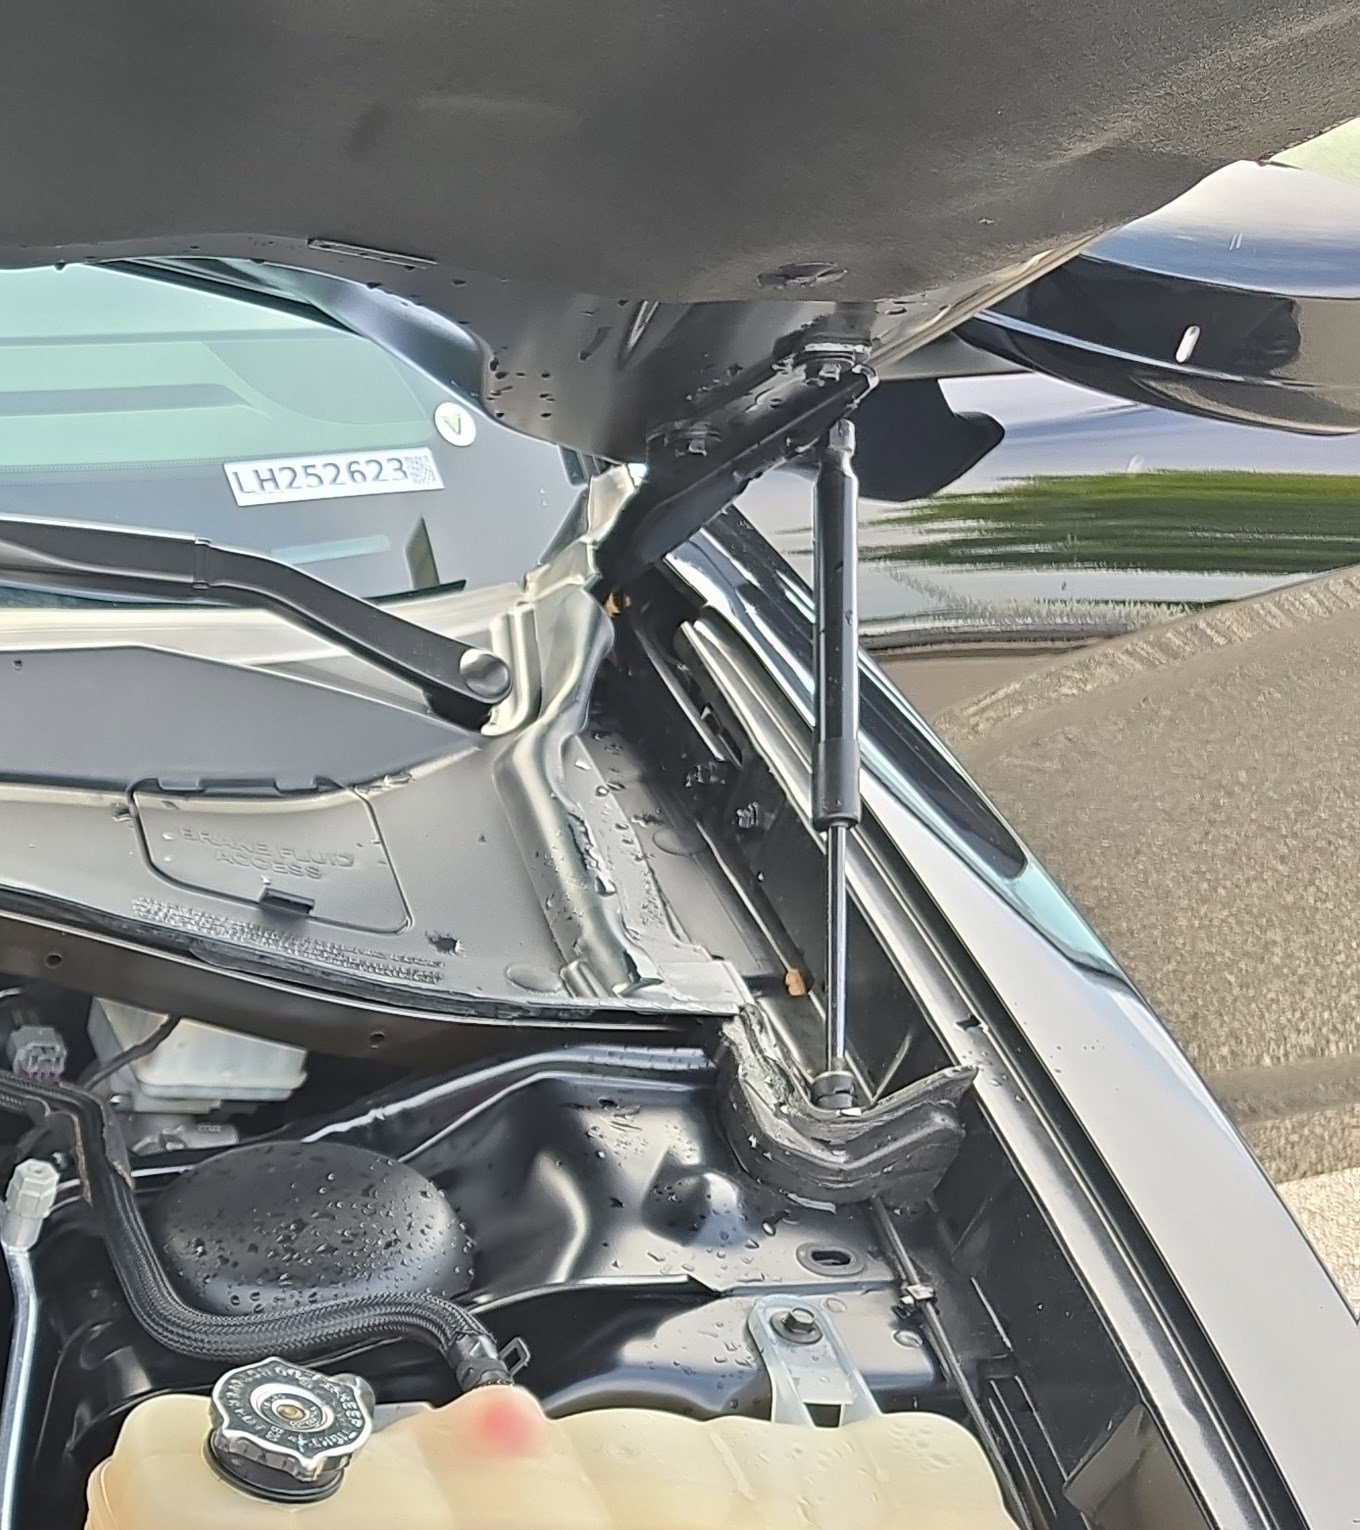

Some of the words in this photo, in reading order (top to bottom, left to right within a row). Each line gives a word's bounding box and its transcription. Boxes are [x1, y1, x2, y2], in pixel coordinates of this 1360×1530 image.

[232, 457, 409, 494] LH252623
[182, 827, 271, 857] BRAKE
[279, 844, 355, 868] FLUID
[214, 848, 323, 880] ACCESS
